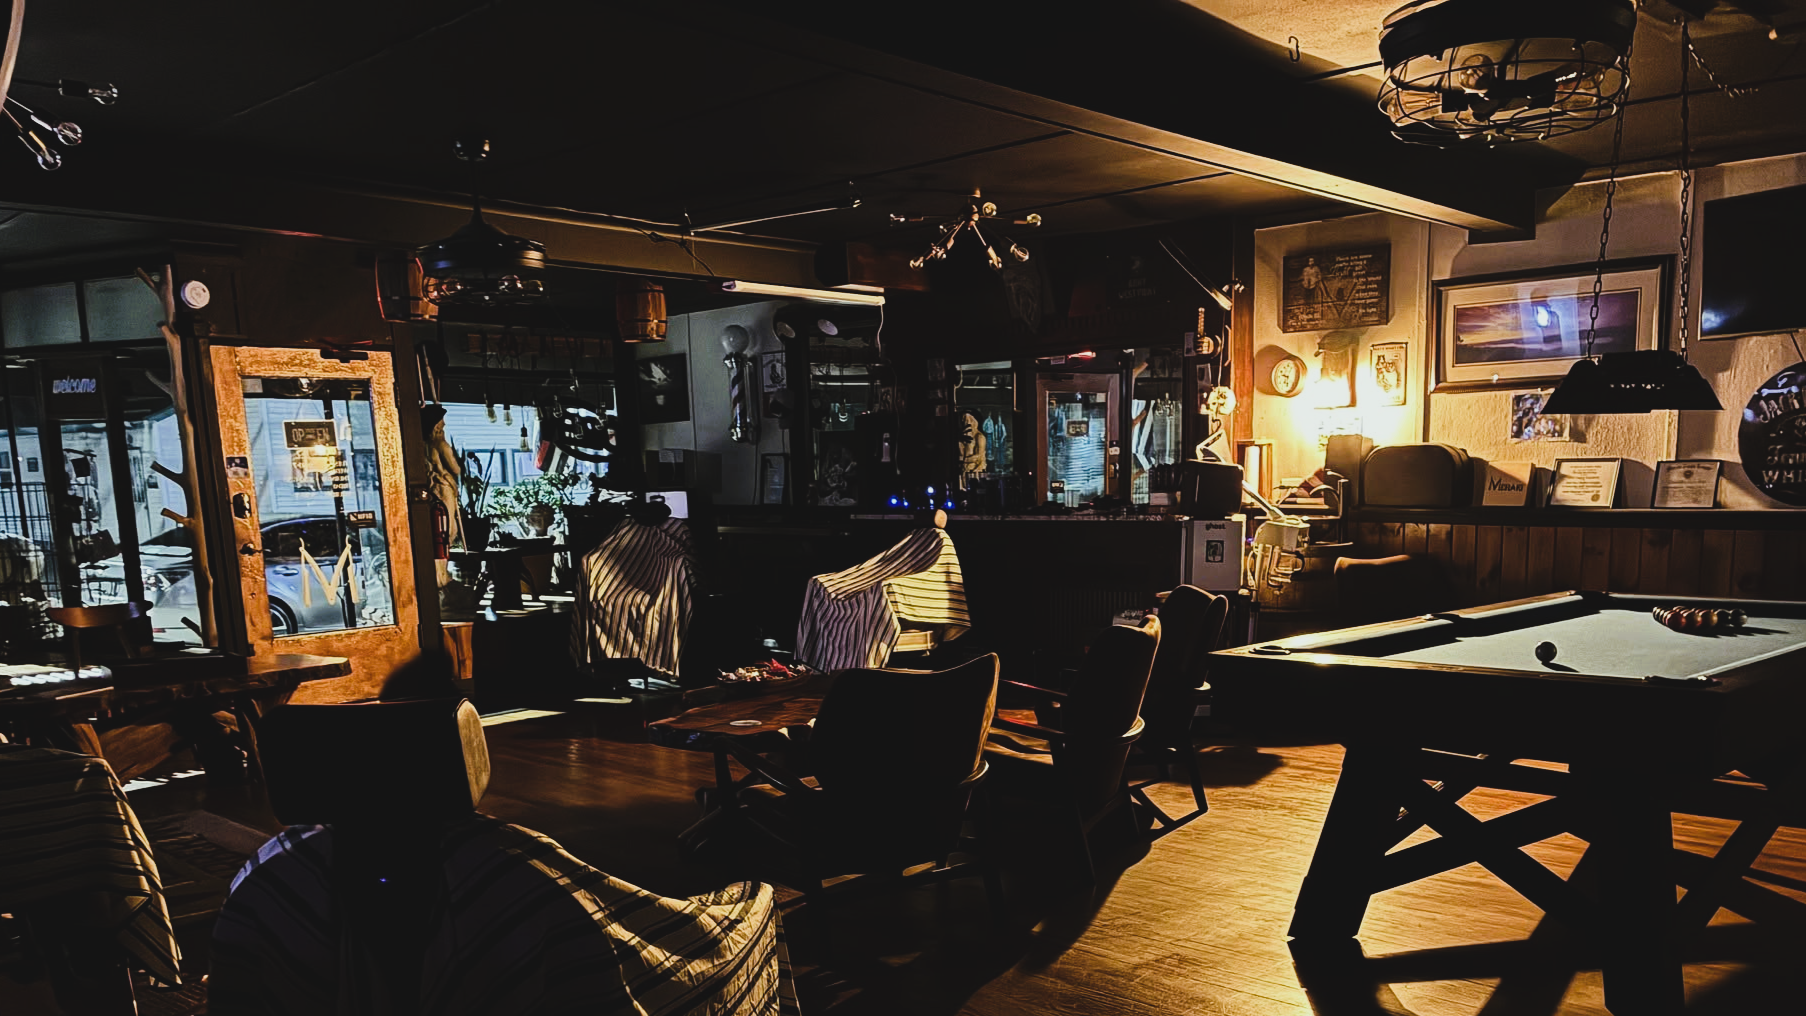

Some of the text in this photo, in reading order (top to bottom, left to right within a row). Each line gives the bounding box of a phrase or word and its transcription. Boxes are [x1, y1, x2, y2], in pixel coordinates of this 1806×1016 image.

[53, 375, 97, 394] welcome
[1759, 393, 1801, 424] JACK
[1488, 475, 1524, 492] MERAKI
[1762, 469, 1806, 484] WHI
[1205, 522, 1227, 531] ghost
